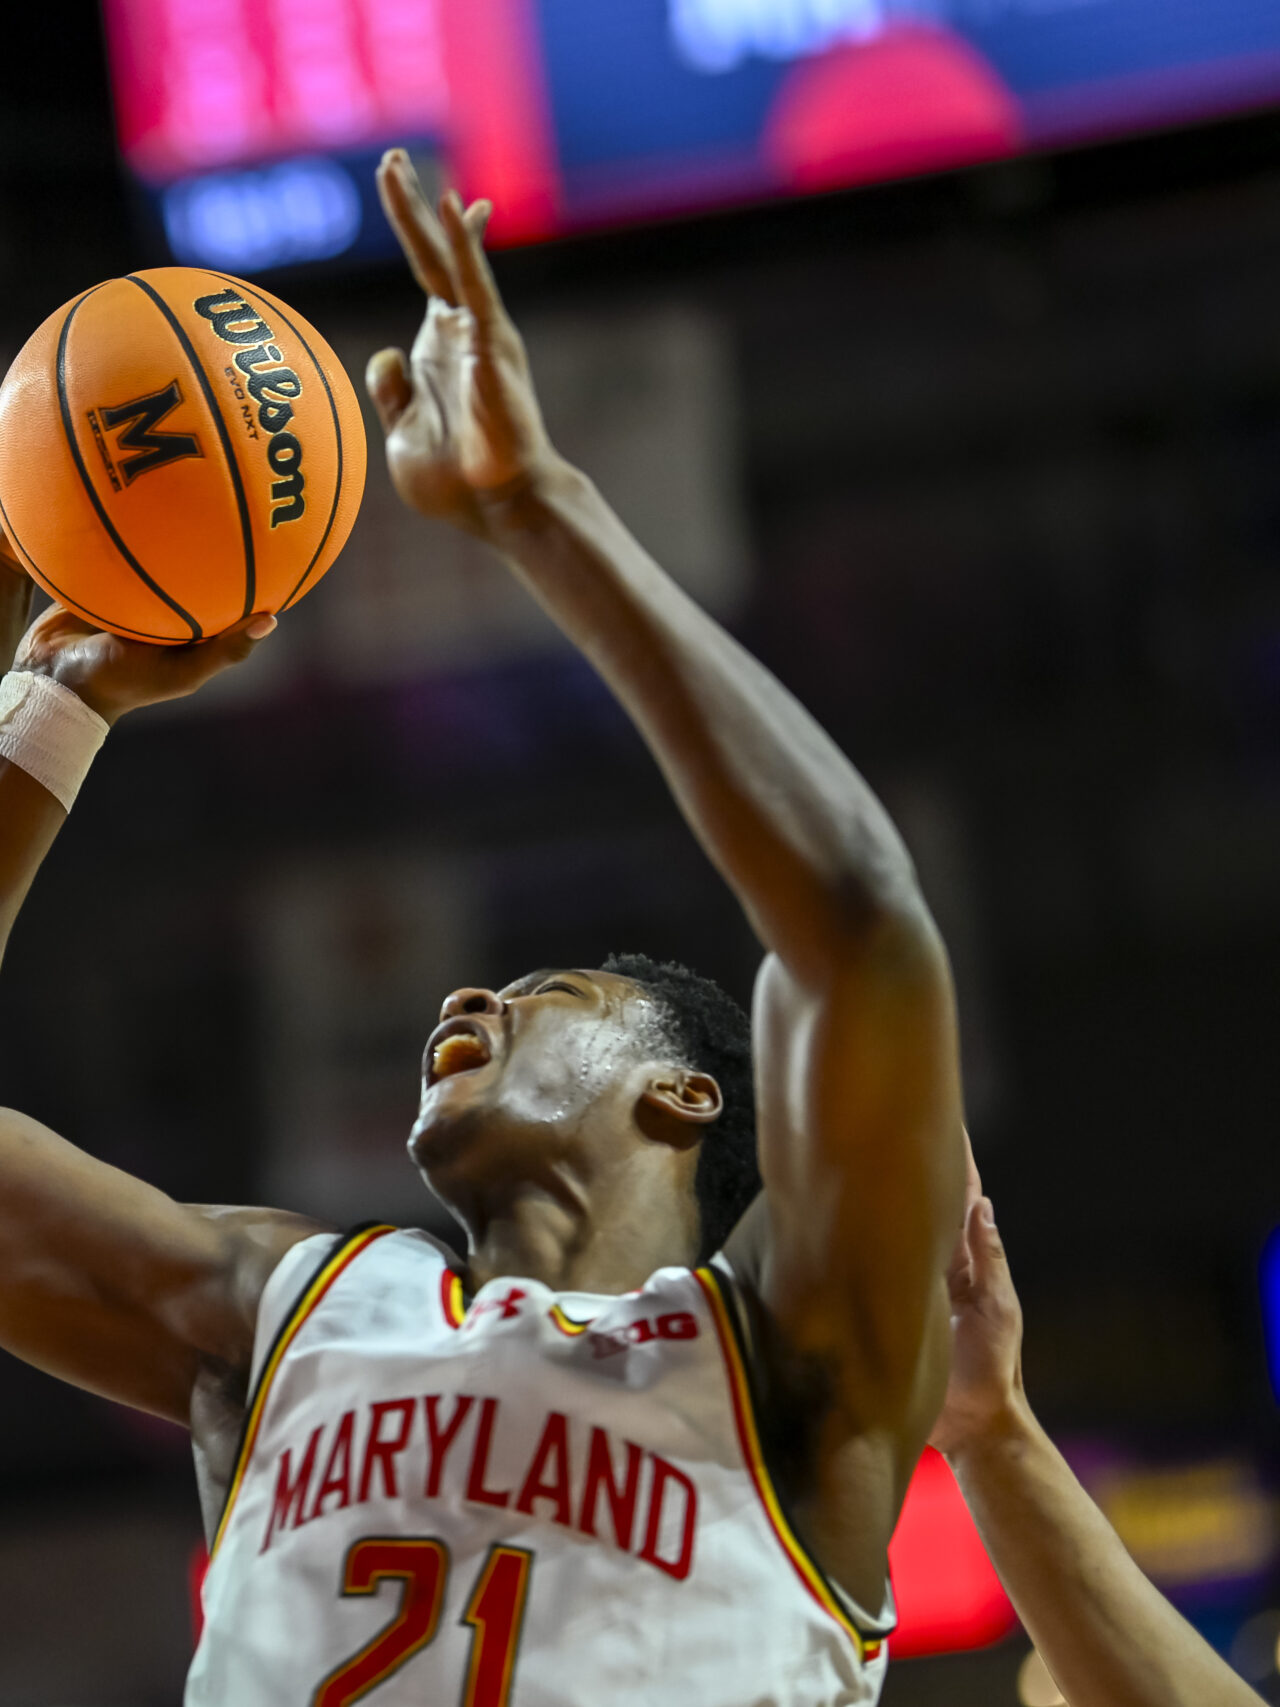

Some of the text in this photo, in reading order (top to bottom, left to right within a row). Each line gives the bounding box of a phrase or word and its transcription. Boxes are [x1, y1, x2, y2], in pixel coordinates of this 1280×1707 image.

[98, 378, 206, 487] M
[193, 288, 305, 529] Wilson
[224, 367, 259, 440] EVO NXT
[259, 1394, 698, 1581] MARYLAND
[312, 1537, 534, 1707] 21
